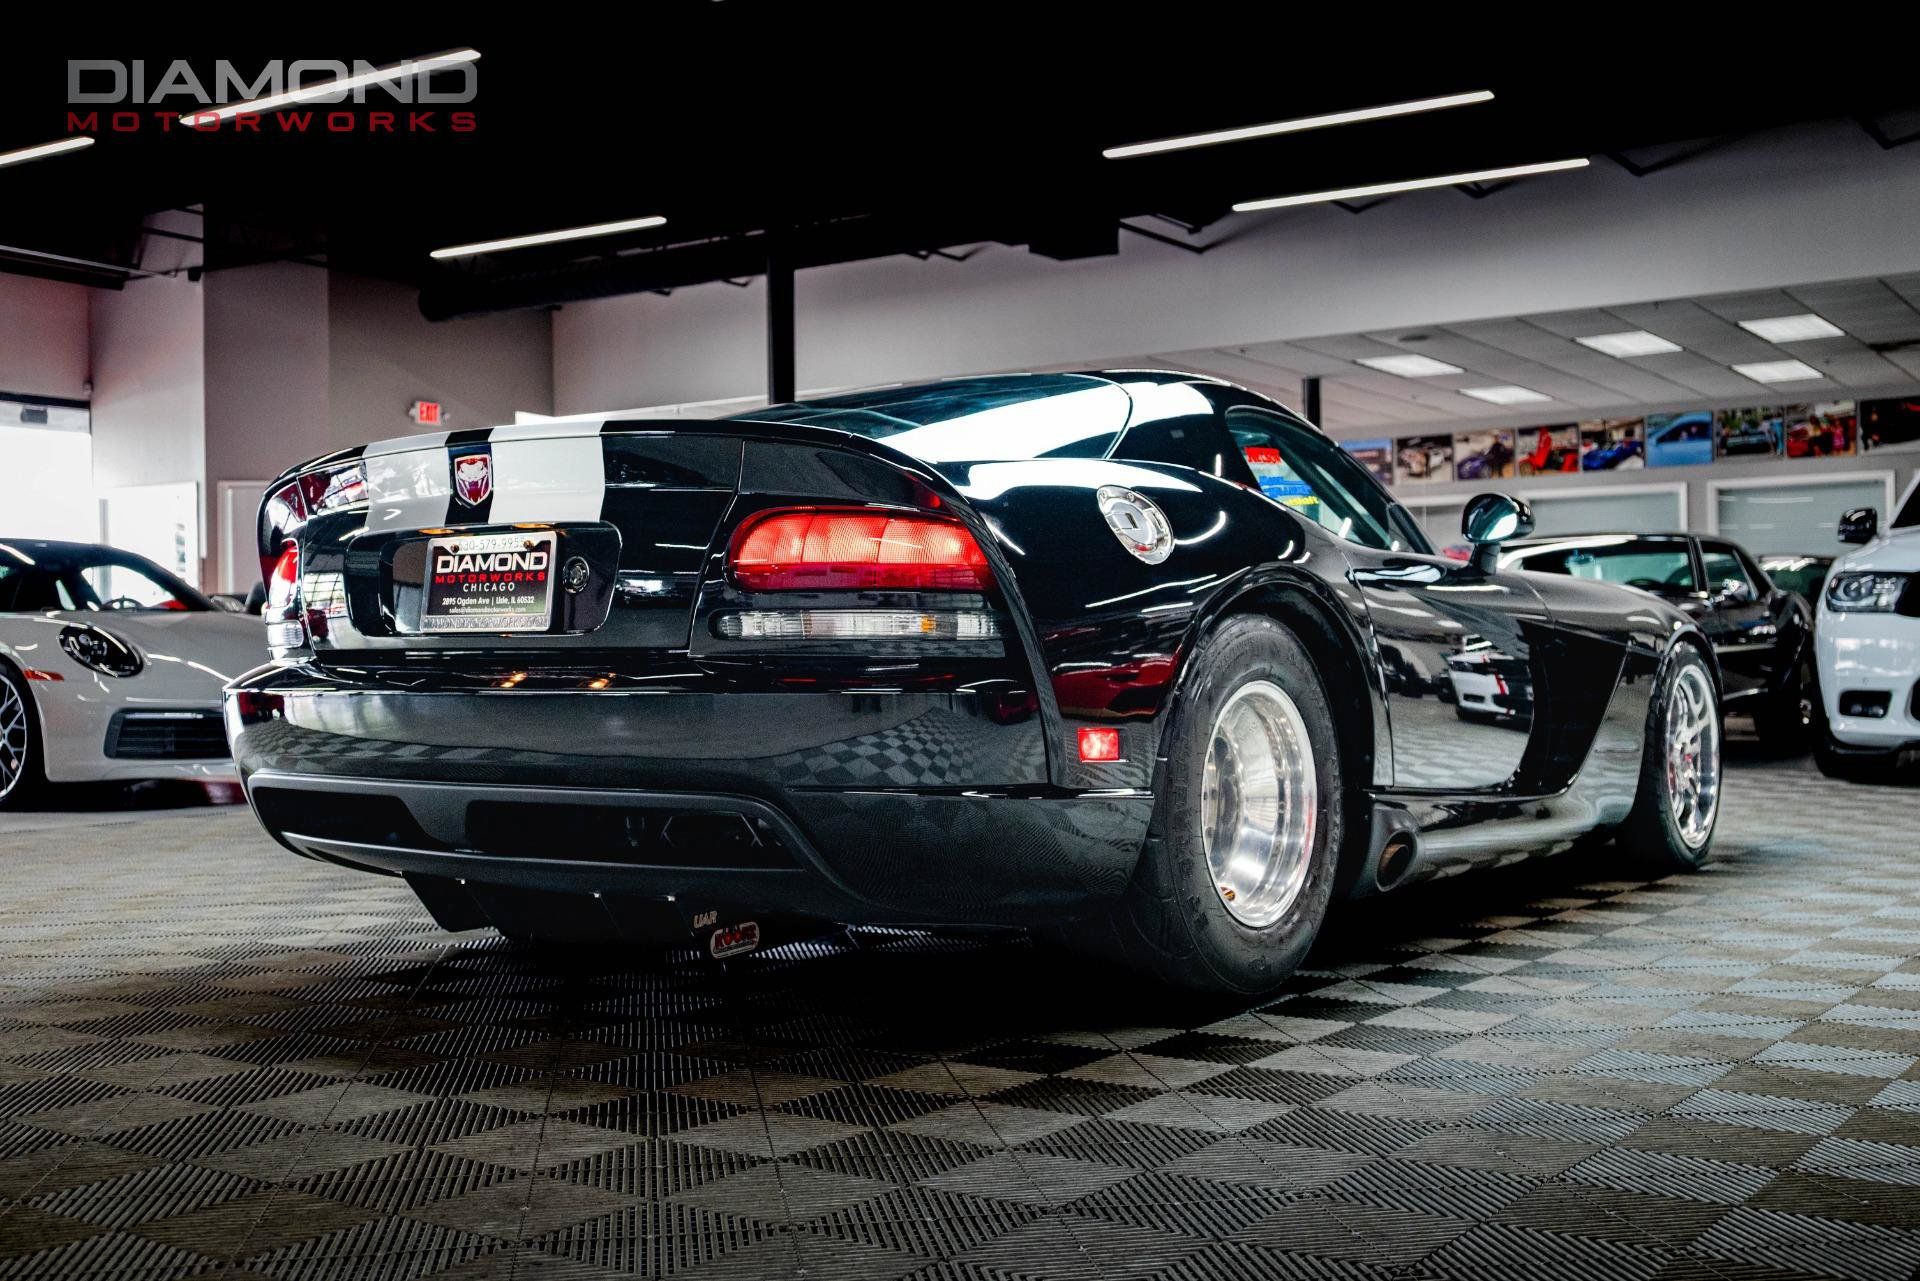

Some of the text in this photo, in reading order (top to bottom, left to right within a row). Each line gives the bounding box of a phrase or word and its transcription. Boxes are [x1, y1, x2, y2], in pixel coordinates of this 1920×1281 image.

[420, 402, 439, 421] EXIT
[436, 552, 548, 574] DIAMOND
[435, 572, 545, 584] MOTORWORKS
[463, 582, 515, 592] CHICAGO
